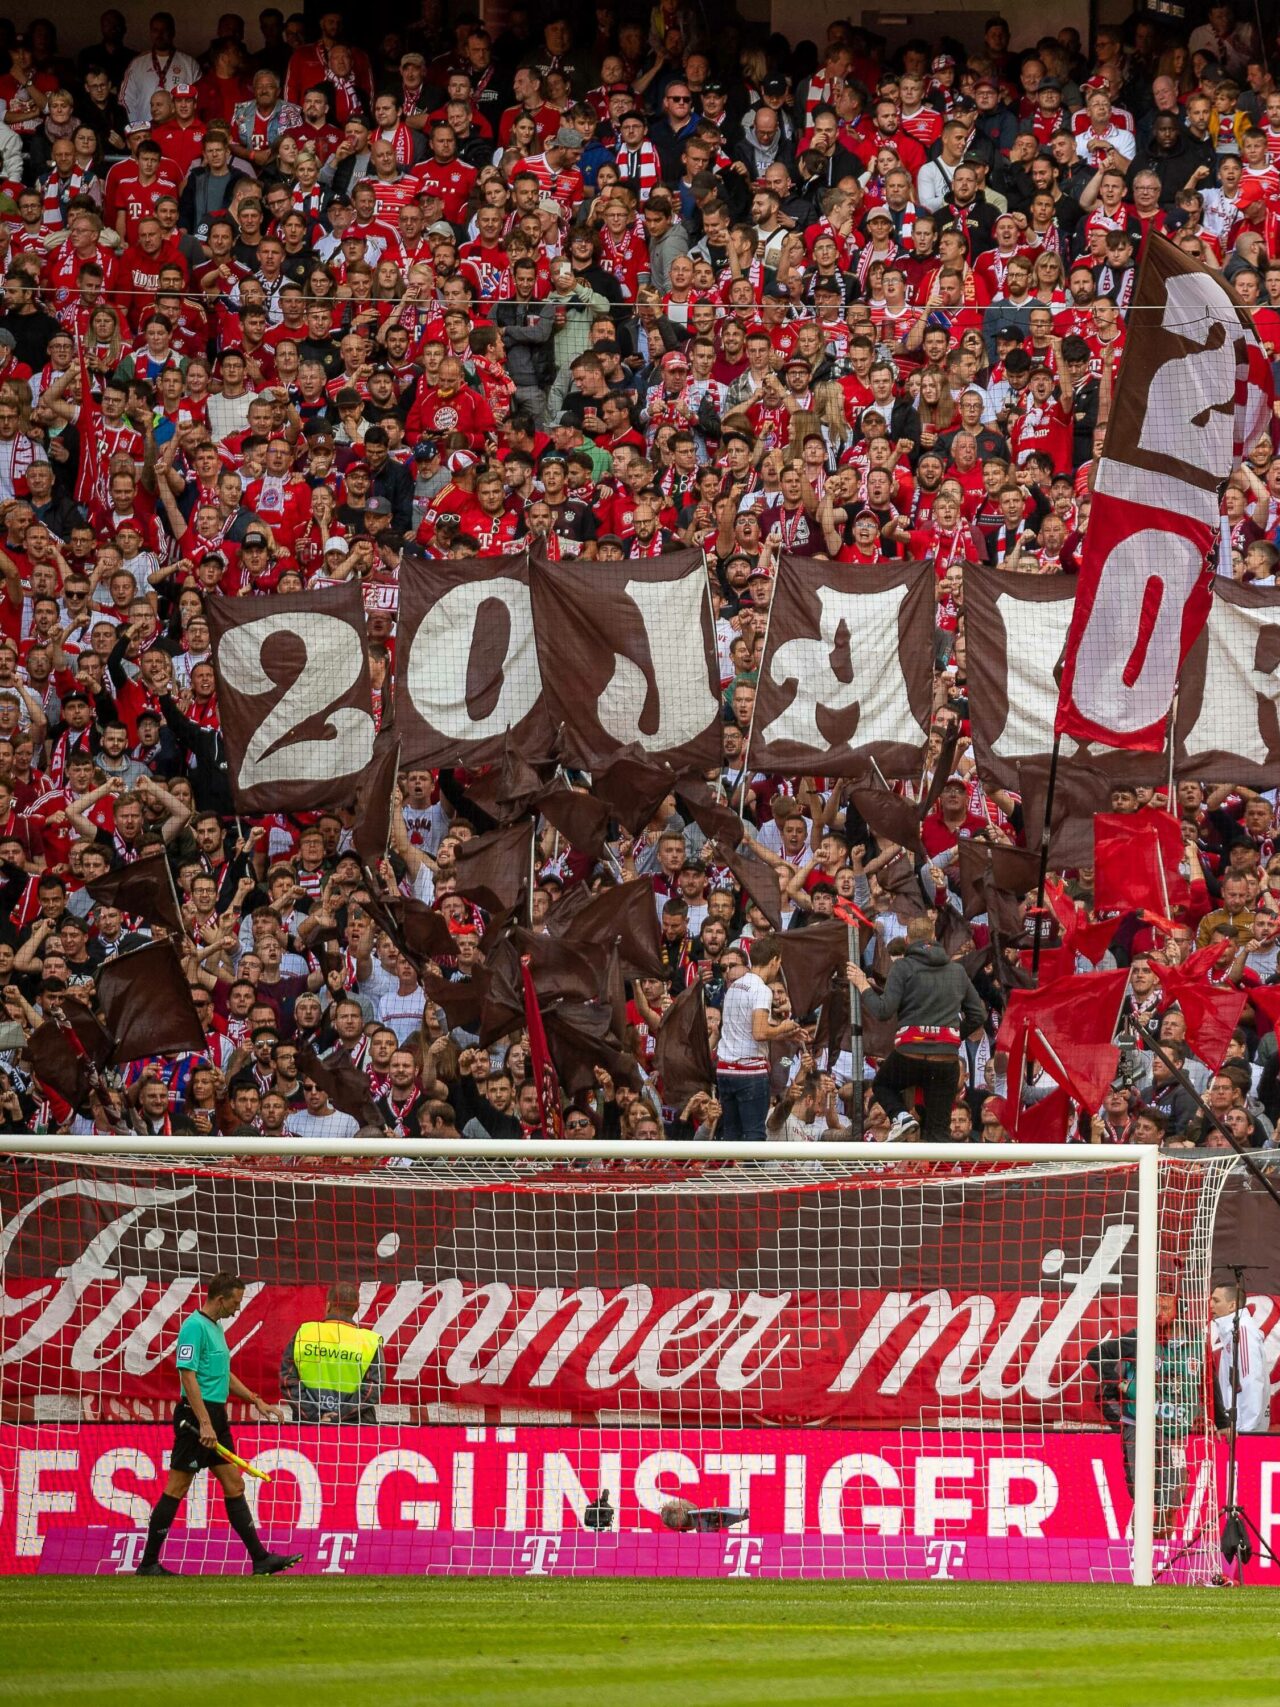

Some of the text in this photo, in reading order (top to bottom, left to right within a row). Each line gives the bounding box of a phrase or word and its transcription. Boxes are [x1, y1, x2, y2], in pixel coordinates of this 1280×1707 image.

[302, 1343, 365, 1364] Steward
[353, 1232, 792, 1391] immer
[826, 1223, 1135, 1400] mit
[0, 1447, 323, 1556] ESTO
[355, 1427, 1060, 1537] GÜNSTIGER
